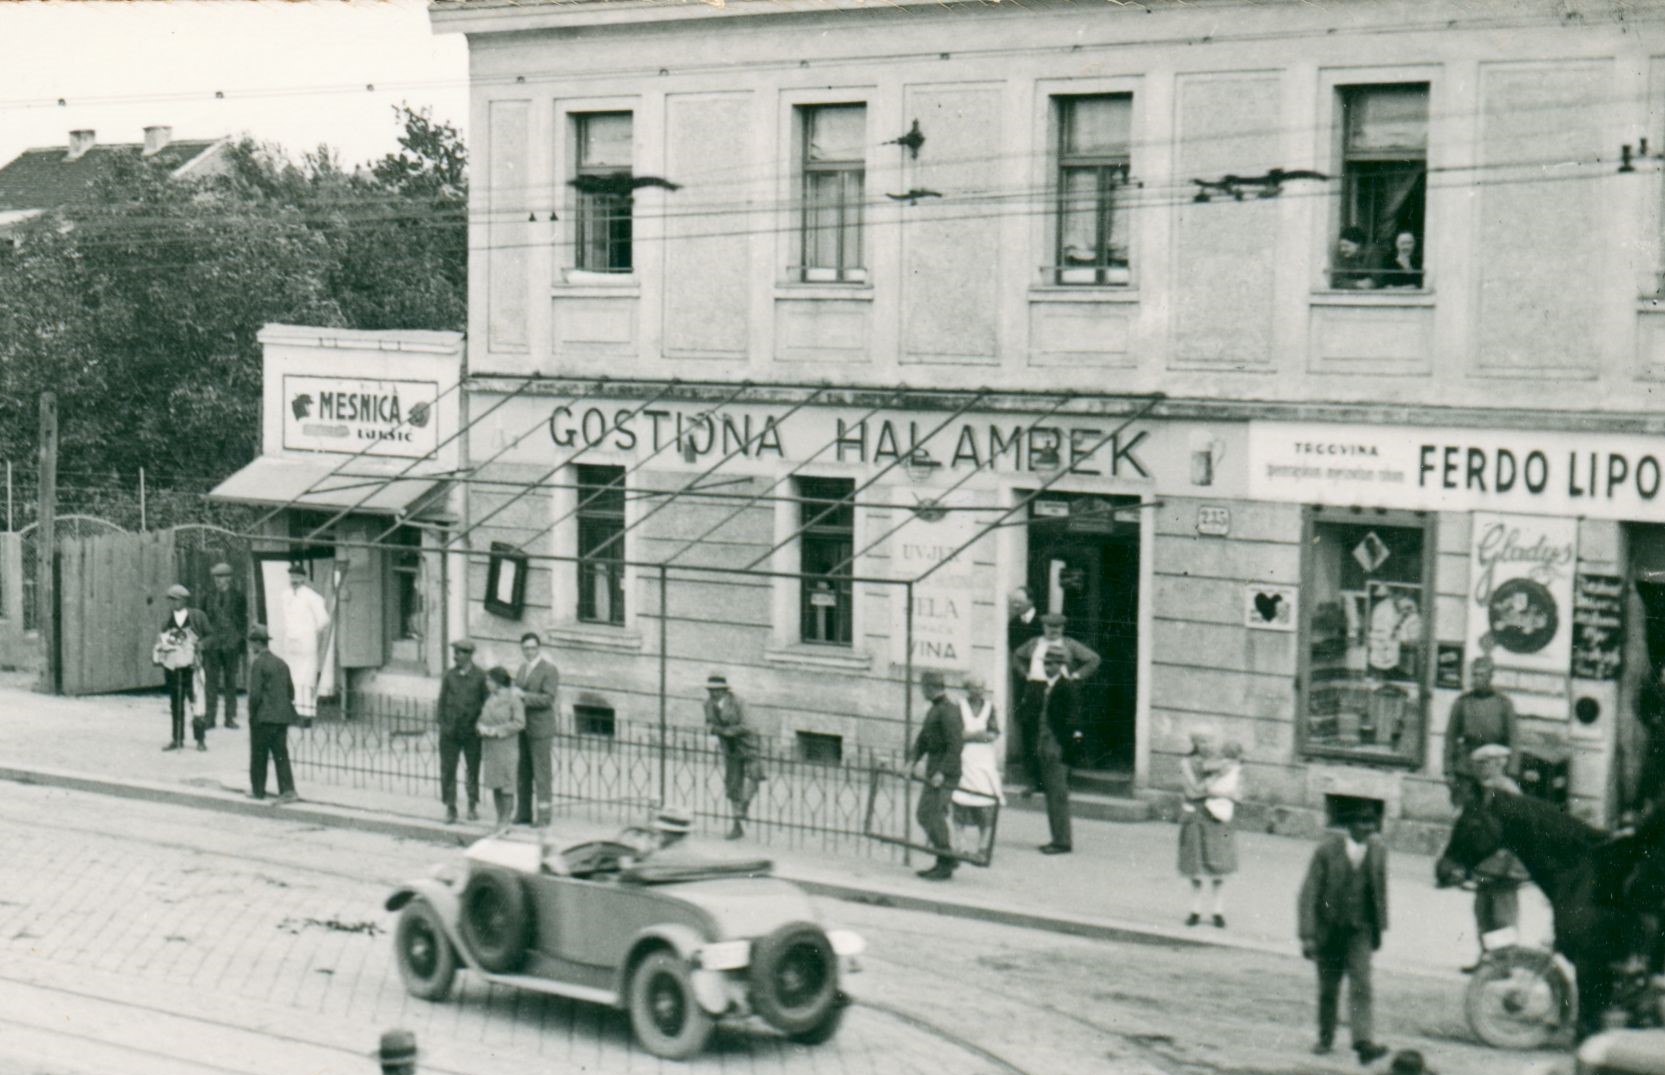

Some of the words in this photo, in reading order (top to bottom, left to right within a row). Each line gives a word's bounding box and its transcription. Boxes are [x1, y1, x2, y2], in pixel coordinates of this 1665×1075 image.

[319, 391, 401, 424] MESNICA
[549, 405, 784, 457] GOSTIONA
[836, 418, 1149, 478] HALAMBEK
[1419, 445, 1549, 494] FERDO
[1569, 451, 1661, 499] LIPO
[1475, 523, 1572, 607] Gladys
